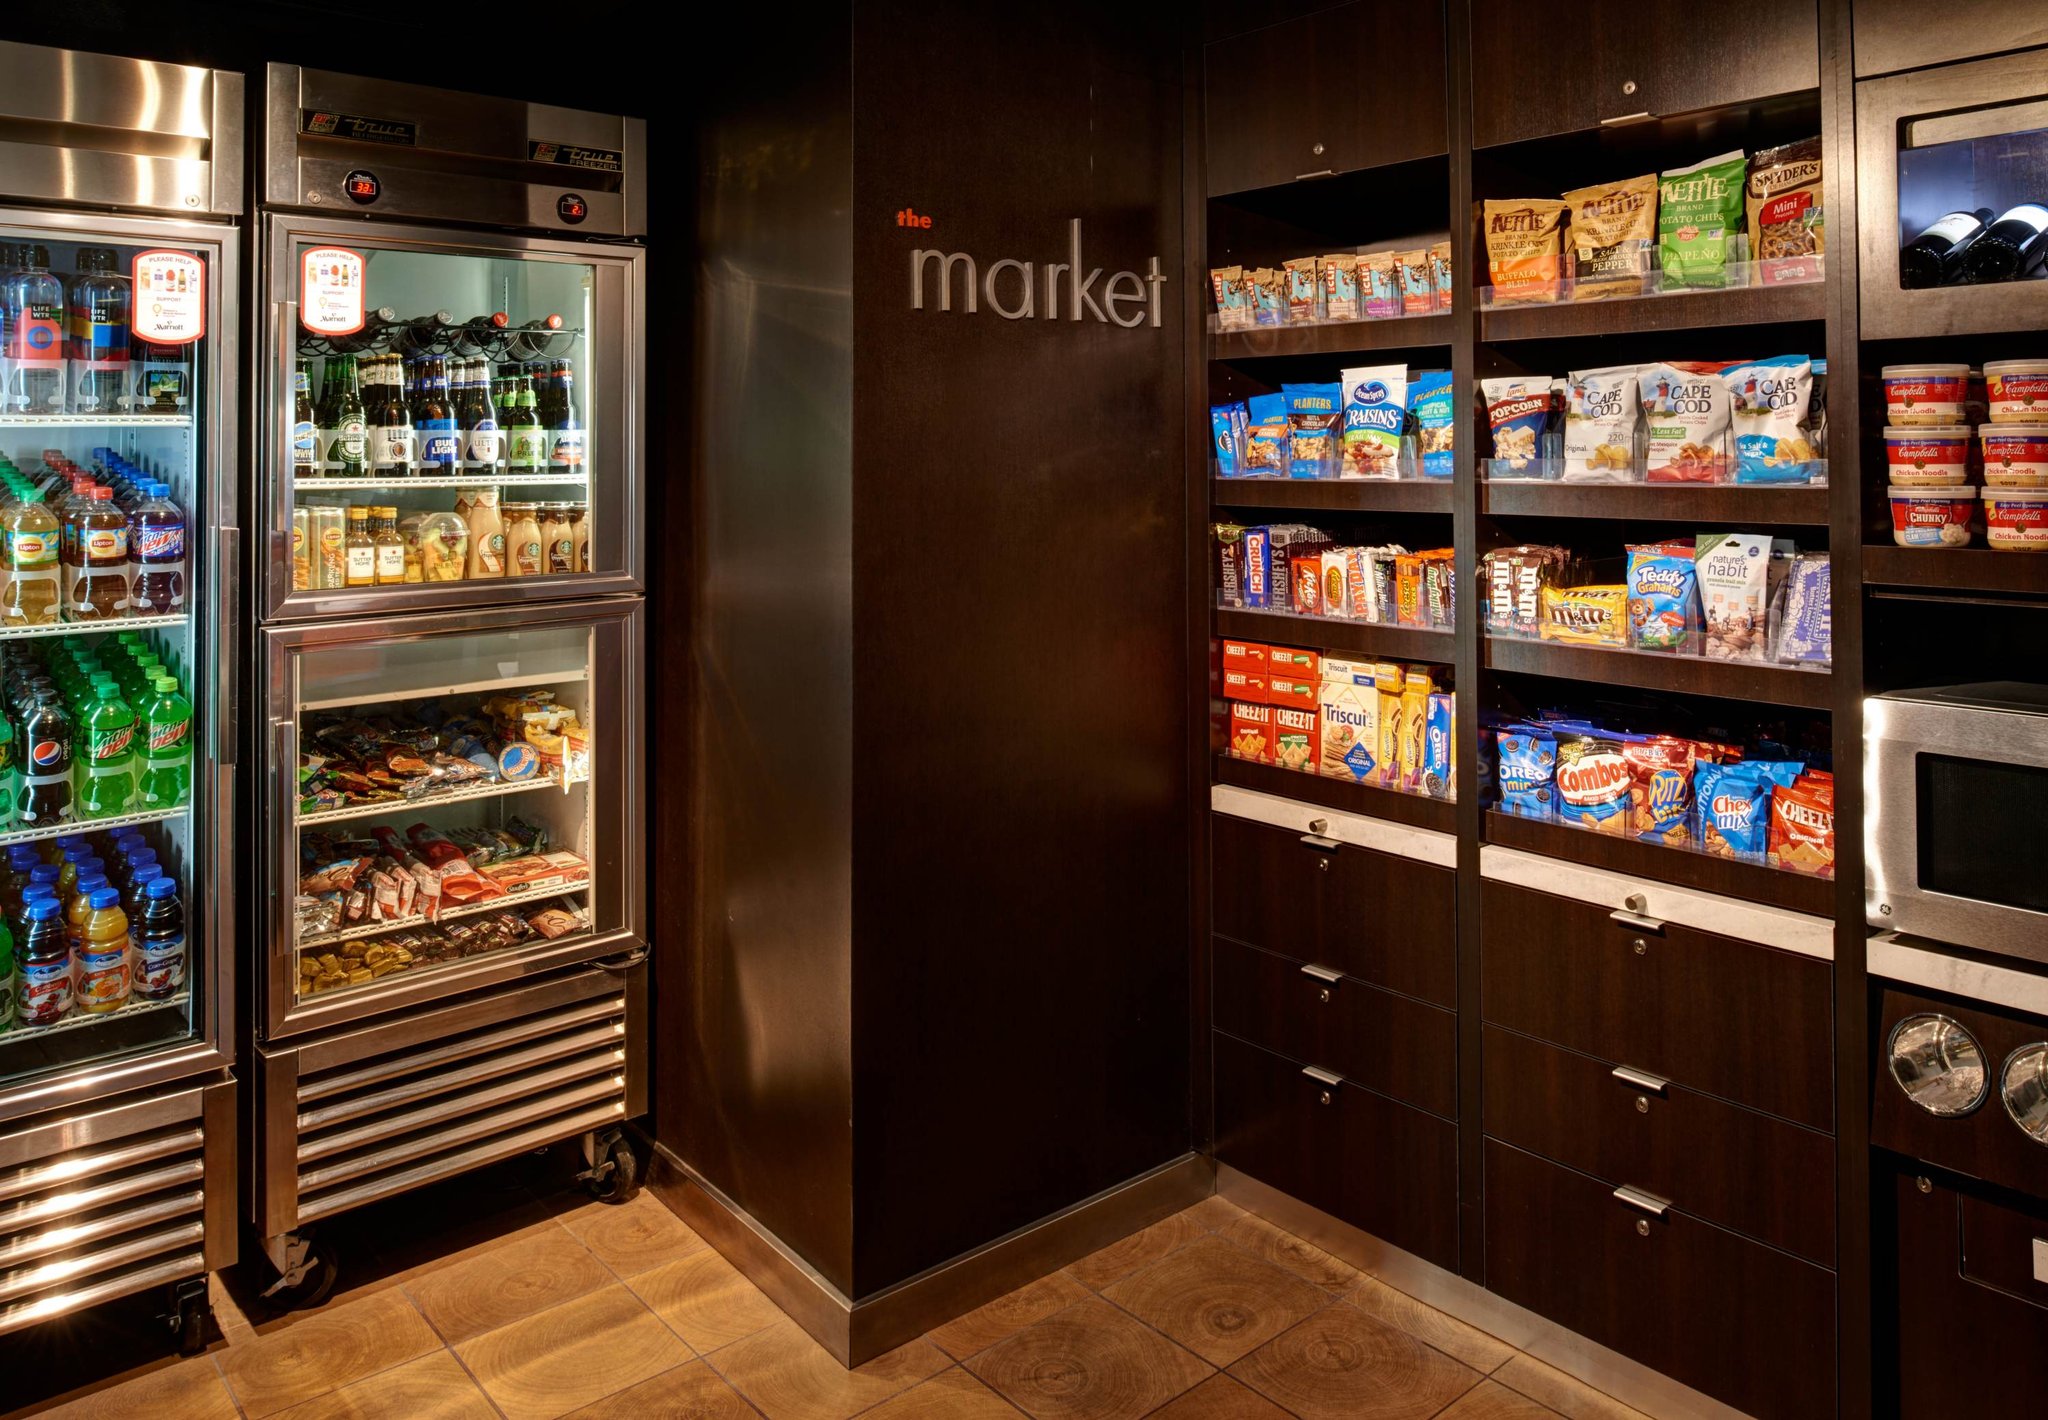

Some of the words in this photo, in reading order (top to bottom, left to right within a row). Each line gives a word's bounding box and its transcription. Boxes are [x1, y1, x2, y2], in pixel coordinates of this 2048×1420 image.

[569, 159, 618, 170] FREEZER
[1755, 161, 1819, 188] SNYDER'S
[1660, 173, 1731, 205] KETTLE
[1676, 203, 1704, 212] BRAND
[1773, 198, 1797, 215] Mini
[897, 208, 932, 230] the
[1695, 212, 1725, 222] CHIPS
[1504, 233, 1528, 241] BRAND
[1490, 240, 1526, 251] KRINKLE
[1600, 246, 1621, 257] SALT
[175, 257, 192, 266] HELP
[1592, 259, 1635, 272] PEPPER
[910, 217, 1168, 328] market
[1361, 265, 1371, 289] CLIF
[1496, 270, 1537, 282] BUFFALO
[1214, 275, 1223, 297] CLIF
[1505, 279, 1530, 289] BLEU
[154, 323, 184, 331] Marriott
[1355, 389, 1371, 401] Ocean
[1369, 389, 1385, 402] Spray
[1506, 385, 1528, 398] Lance
[1671, 385, 1712, 400] CAPE
[1890, 384, 1927, 396] Campbell's
[1293, 397, 1332, 410] PLANTERS
[1587, 389, 1623, 406] CAPE
[1767, 391, 1799, 412] COD
[1490, 398, 1544, 420] POPCORN
[1590, 402, 1623, 419] COD
[1673, 399, 1713, 415] COD
[1345, 408, 1402, 430] CRAISINS
[1608, 433, 1624, 442] 220
[1656, 427, 1671, 435] Less
[431, 446, 457, 455] LIGHT
[1898, 445, 1938, 459] Campbell's
[1987, 444, 2026, 457] Campbell's
[1910, 512, 1948, 524] CHUNKY
[1998, 508, 2041, 522] Campbell's
[19, 543, 41, 551] Lipton
[92, 539, 114, 548] Lipton
[1249, 537, 1263, 592] CRUNCH
[1712, 554, 1746, 565] nature's
[1221, 547, 1236, 601] HERSHEY'S
[1638, 566, 1685, 587] Teddy
[1707, 562, 1748, 579] habit
[1271, 549, 1287, 615] HERSHEY'S
[1637, 582, 1683, 598] Grahams
[1328, 663, 1348, 674] Triscuit
[1430, 726, 1441, 769] OREO
[1347, 756, 1371, 767] ORIGINAL
[1499, 765, 1551, 782] OREO
[1558, 760, 1629, 793] Combos
[1650, 774, 1687, 807] RITZ
[1712, 794, 1752, 816] Chex
[1717, 812, 1752, 831] mix
[1790, 833, 1825, 845] ORIGINAL
